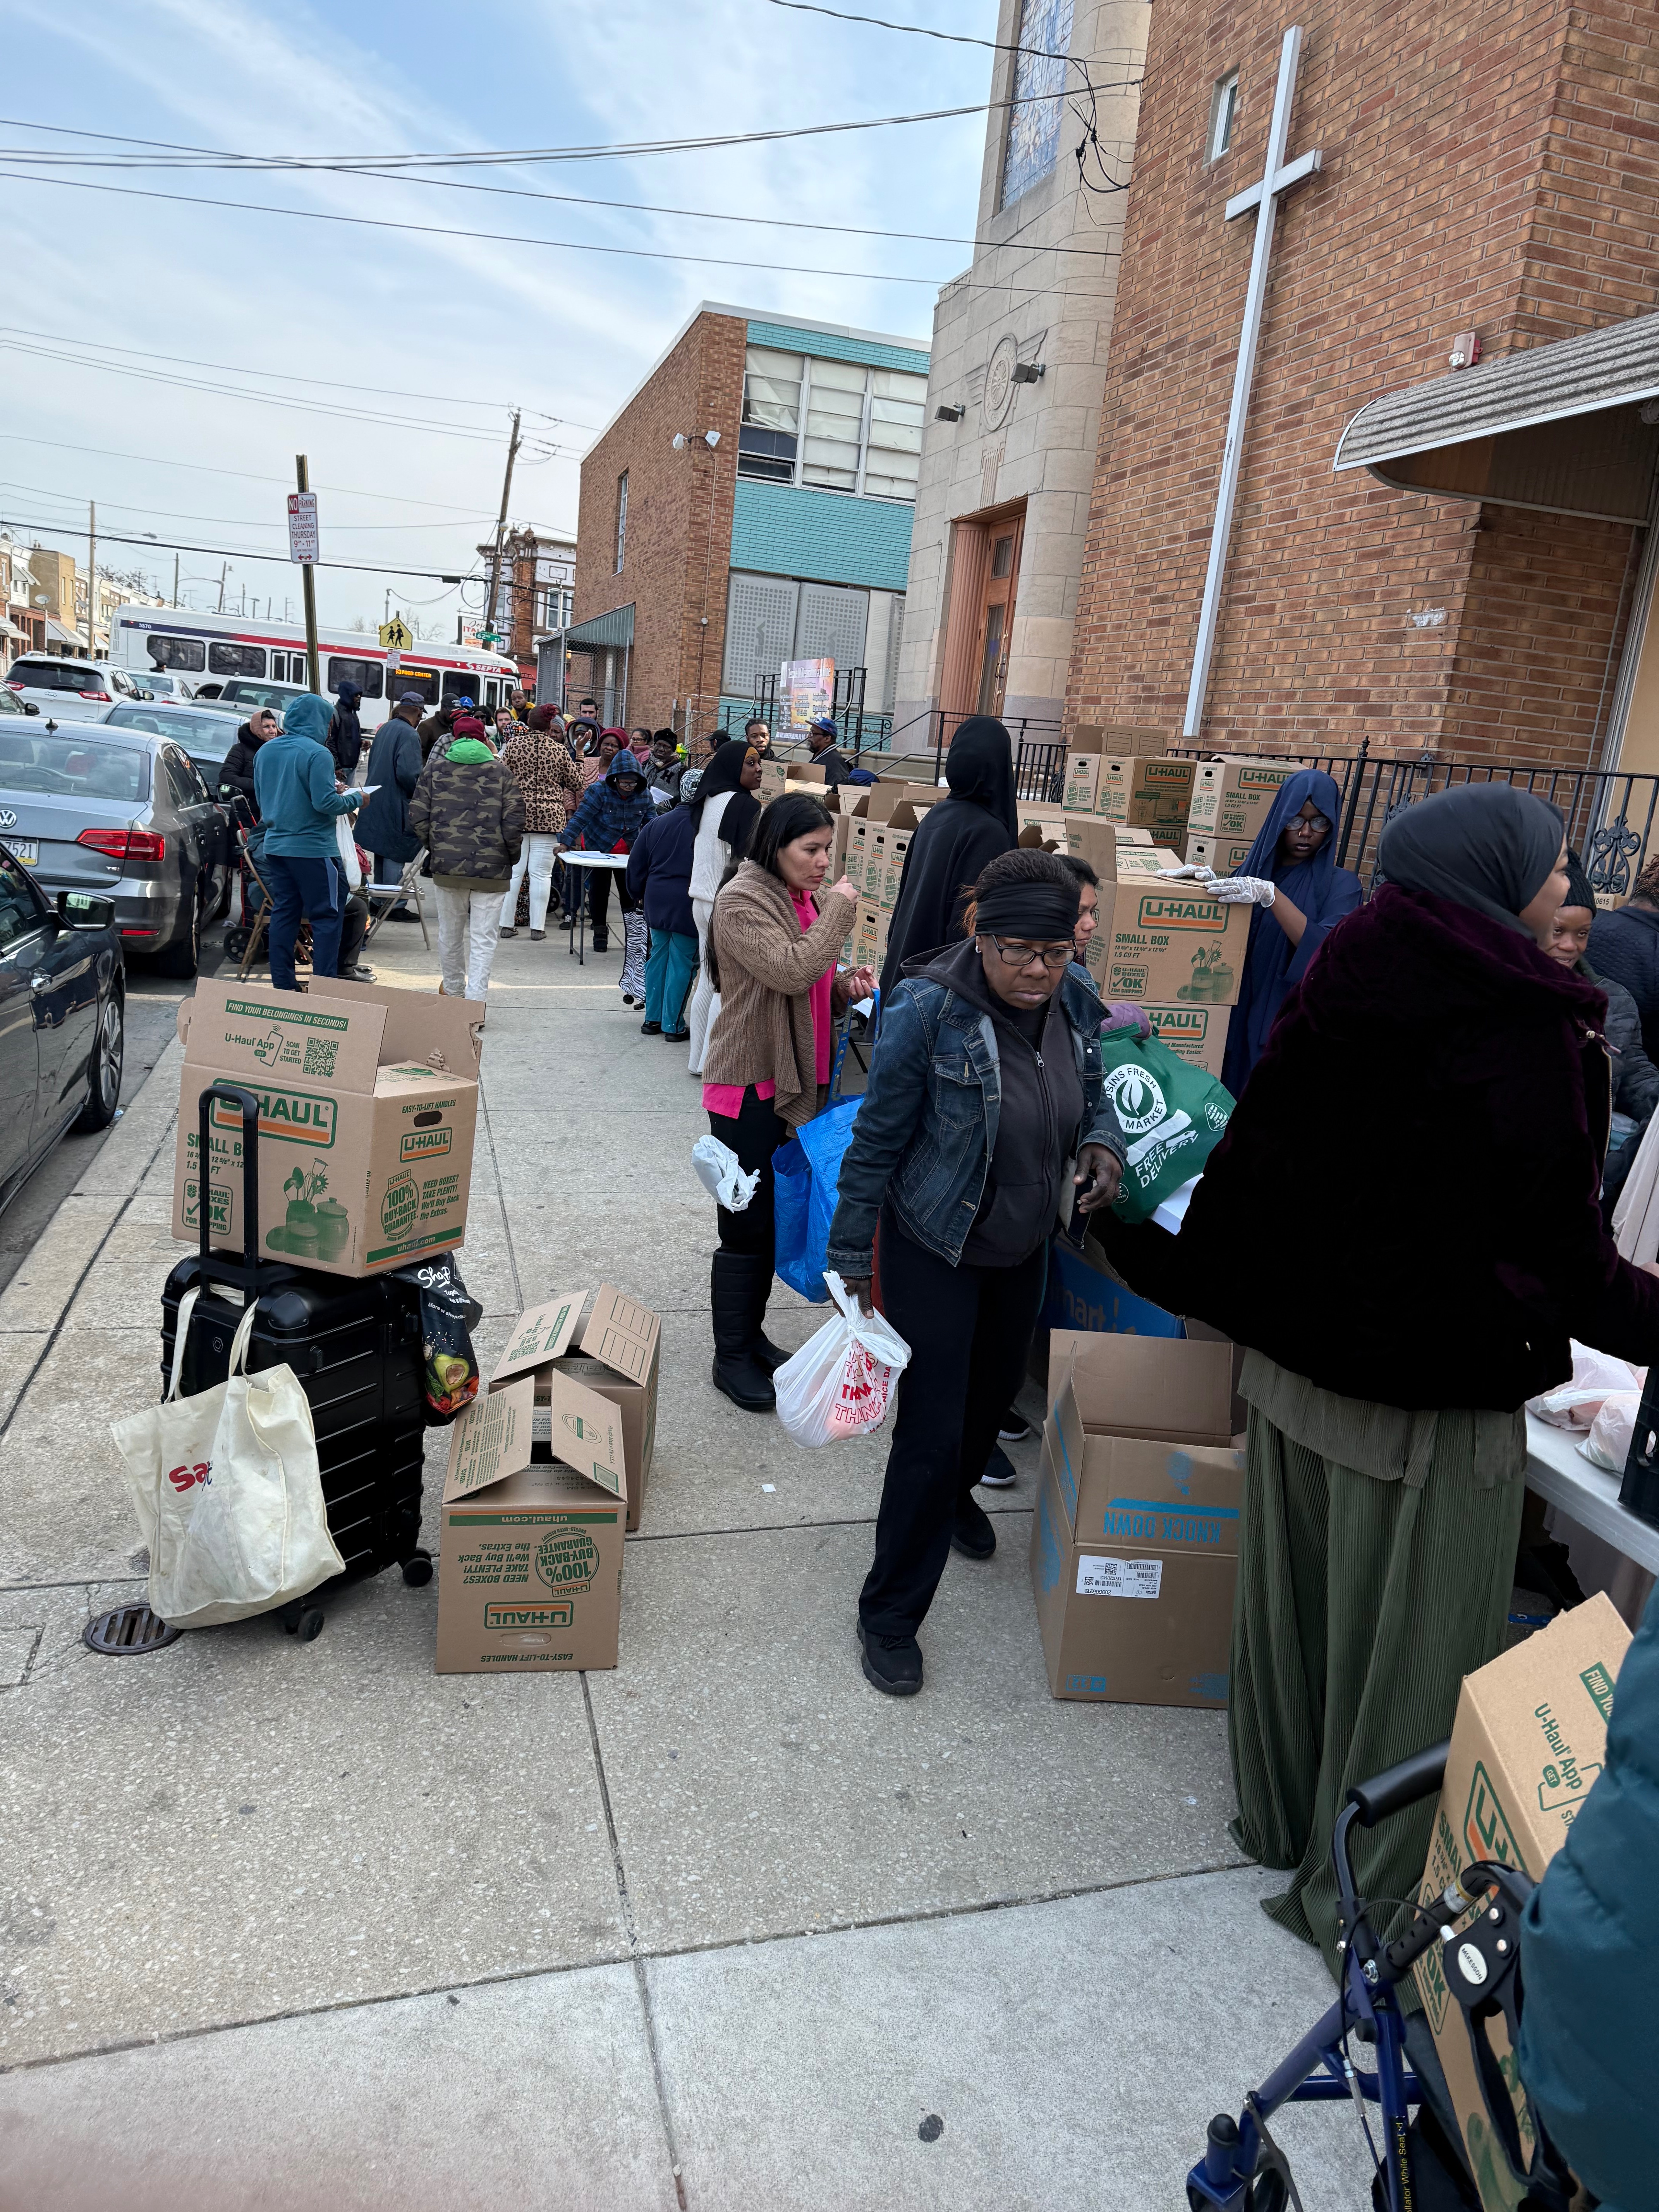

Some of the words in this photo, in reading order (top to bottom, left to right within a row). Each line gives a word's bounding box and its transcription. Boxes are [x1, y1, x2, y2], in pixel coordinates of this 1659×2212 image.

[289, 497, 297, 511] NO
[299, 499, 314, 508] PARKING
[475, 665, 501, 673] SEPTA
[660, 769, 675, 784] H
[1149, 767, 1188, 778] U-HAUL
[1243, 771, 1288, 784] U-HAU
[1226, 792, 1246, 800] SMALL
[1151, 831, 1179, 840] -HAUL
[1146, 902, 1223, 921] U-HAUL
[1116, 933, 1147, 944] SMALL
[1151, 936, 1170, 945] BOX
[1123, 978, 1143, 988] OK
[228, 1003, 243, 1012] FIND
[245, 1005, 261, 1015] YOUR
[262, 1008, 304, 1021] BELONGINGS
[313, 1016, 347, 1028] SECONDS!
[1149, 1013, 1202, 1028] HAUL
[225, 1033, 256, 1046] U-Haul
[257, 1039, 275, 1050] App
[280, 1056, 301, 1064] STARTED
[1107, 1071, 1125, 1099] USINS
[1127, 1068, 1156, 1089] FRESH
[220, 1094, 328, 1127] UHAUL
[402, 1103, 434, 1114] EASY-TO-LIFT
[435, 1099, 456, 1109] HANDLES
[1125, 1099, 1164, 1129] MARKET
[404, 1132, 449, 1151] U-HAUL
[1135, 1142, 1164, 1177] FREE
[1140, 1133, 1199, 1188] DELIVERY
[187, 1161, 197, 1170] 1.5
[211, 1165, 221, 1175] FT
[389, 1171, 410, 1185] U-HAUL
[423, 1179, 438, 1190] NEED
[439, 1174, 459, 1183] BOXES?
[210, 1190, 230, 1199] HAUL
[387, 1183, 413, 1209] 100%
[422, 1189, 436, 1200] TAKE
[436, 1184, 458, 1196] PLENTY!
[421, 1199, 434, 1210] We'll
[435, 1198, 445, 1207] Buy
[447, 1194, 460, 1204] Back
[384, 1198, 416, 1224] BUY-BACK
[420, 1212, 429, 1220] the
[430, 1208, 448, 1218] Extras.
[186, 1216, 197, 1224] FOR
[210, 1221, 227, 1231] PPING
[398, 1237, 435, 1252] uhaul.com
[428, 1302, 440, 1310] More
[883, 1366, 892, 1378] DA
[1104, 1511, 1156, 1539] DOWN
[1162, 1517, 1221, 1543] KNOCK
[479, 1543, 512, 1551] Extras.
[458, 1554, 482, 1562] Back
[485, 1553, 501, 1563] Buy
[506, 1553, 529, 1561] We'll
[540, 1547, 594, 1566] BUY-BACK
[464, 1565, 502, 1573] PLENTY!
[505, 1564, 529, 1572] TAKE
[546, 1561, 592, 1583] 100%
[463, 1575, 499, 1583] BOXES?
[503, 1574, 529, 1582] NEED
[555, 1585, 588, 1595] U-HAUL
[492, 1611, 567, 1625] U-HAUL
[1584, 1669, 1609, 1695] FIND
[1600, 1693, 1614, 1716] YO
[1534, 1703, 1568, 1757] U-Haul
[1558, 1757, 1583, 1790] App
[1546, 1770, 1556, 1783] GET
[1400, 2157, 1410, 2183] While
[1403, 2186, 1413, 2212] ollator
